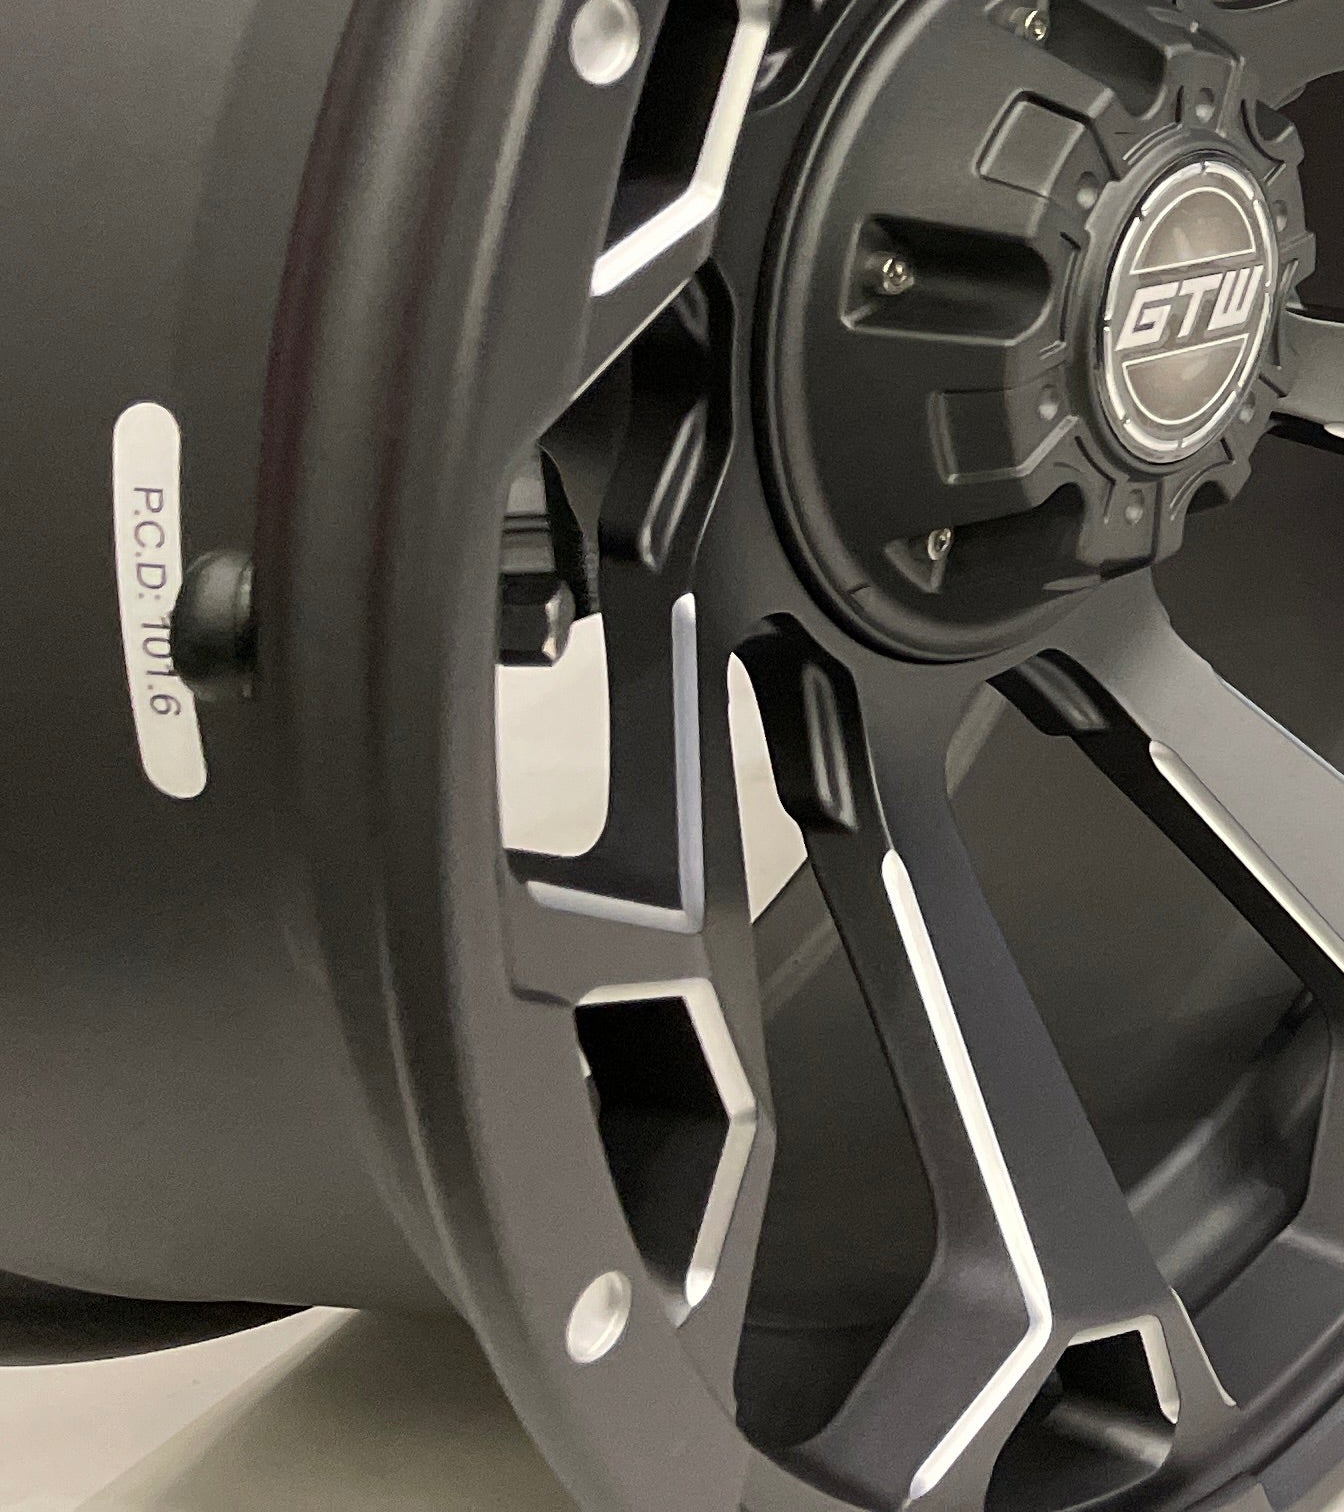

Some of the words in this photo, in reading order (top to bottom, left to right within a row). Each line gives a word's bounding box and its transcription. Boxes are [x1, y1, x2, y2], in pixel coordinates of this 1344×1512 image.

[1115, 265, 1264, 351] GTW
[133, 487, 168, 600] P.C.D:
[141, 612, 182, 717] 101.6
